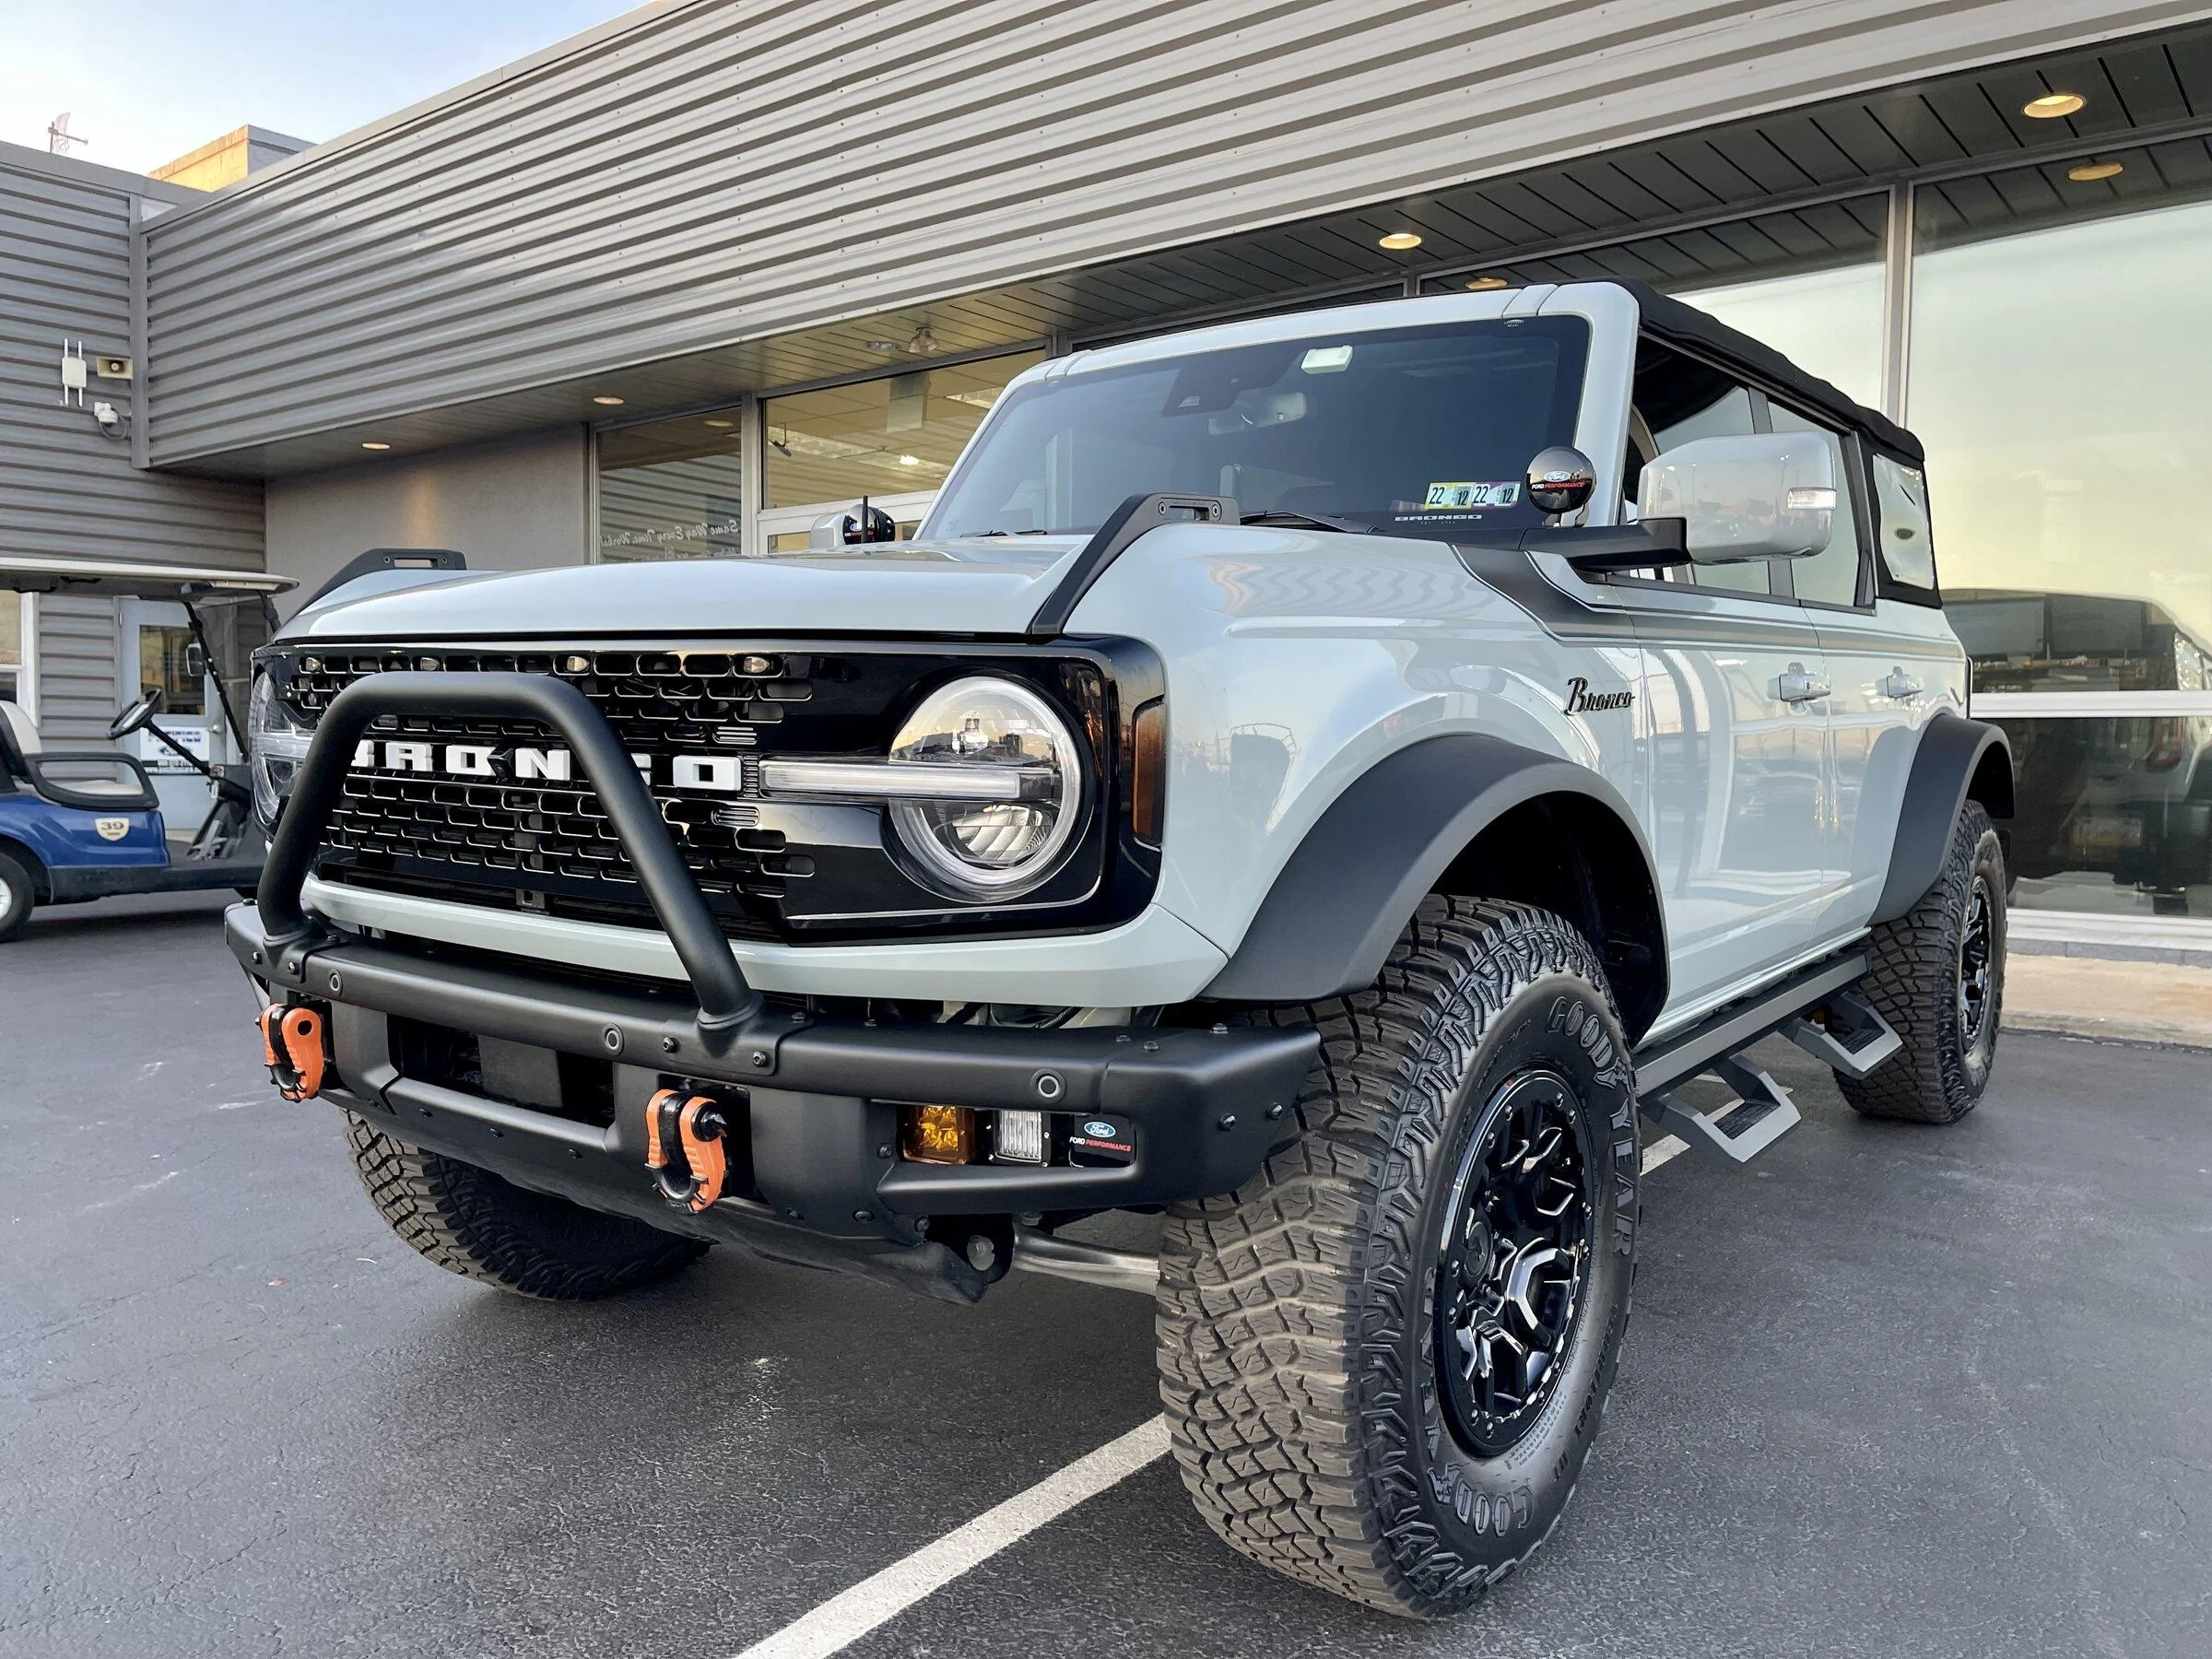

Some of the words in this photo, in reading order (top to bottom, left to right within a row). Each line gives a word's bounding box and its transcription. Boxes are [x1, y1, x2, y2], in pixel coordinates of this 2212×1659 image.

[1430, 488, 1444, 504] 22
[1457, 490, 1469, 506] 12
[1474, 486, 1488, 503] 22
[1502, 488, 1514, 503] 12
[1564, 677, 1635, 716] Bronco
[100, 821, 124, 830] 39
[1069, 1136, 1086, 1145] FORD
[1086, 1139, 1132, 1152] PERFORMANCE
